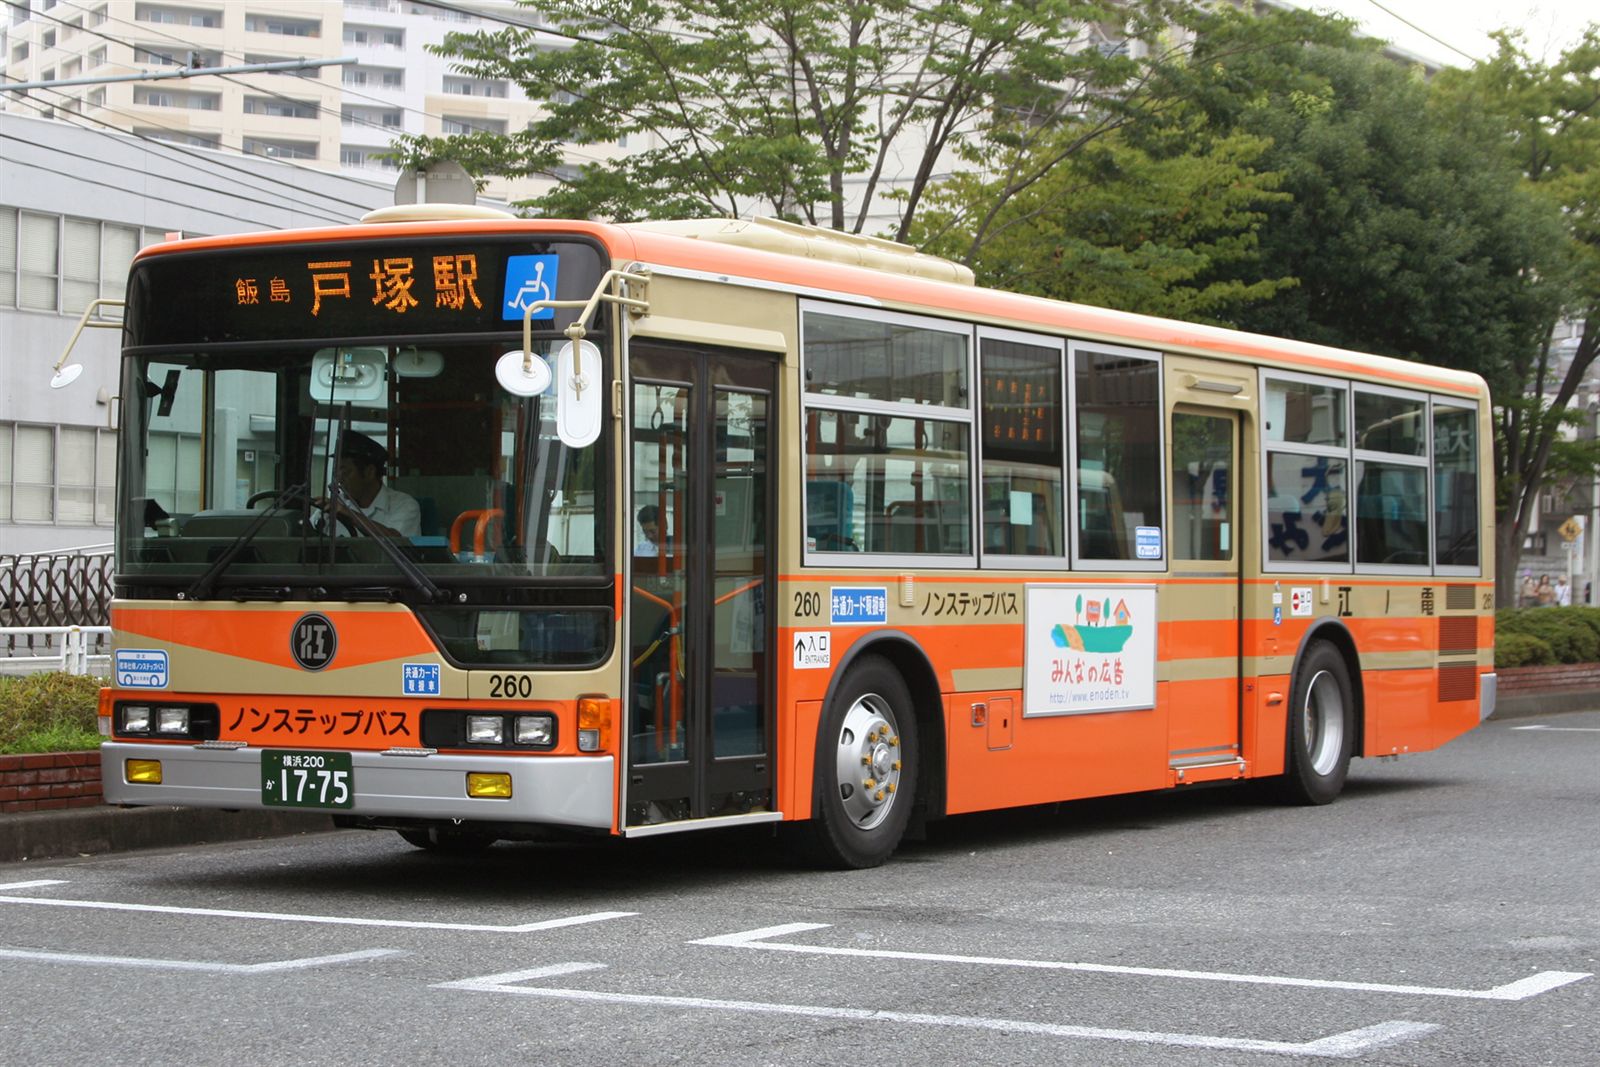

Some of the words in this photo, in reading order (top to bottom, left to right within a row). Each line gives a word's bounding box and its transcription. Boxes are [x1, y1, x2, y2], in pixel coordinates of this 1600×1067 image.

[234, 276, 291, 305] 飯島
[307, 254, 482, 316] 戸塚駅
[794, 591, 821, 617] 260
[921, 592, 1018, 616] ノンステップバス
[808, 635, 827, 652] 入口
[805, 654, 829, 664] ENTRANCE
[1051, 657, 1124, 685] みんなの広告
[405, 666, 438, 679] 共通カード
[489, 674, 532, 698] 260
[229, 707, 411, 736] ノンステップバス
[265, 779, 276, 790] か
[281, 769, 349, 804] 17-75
